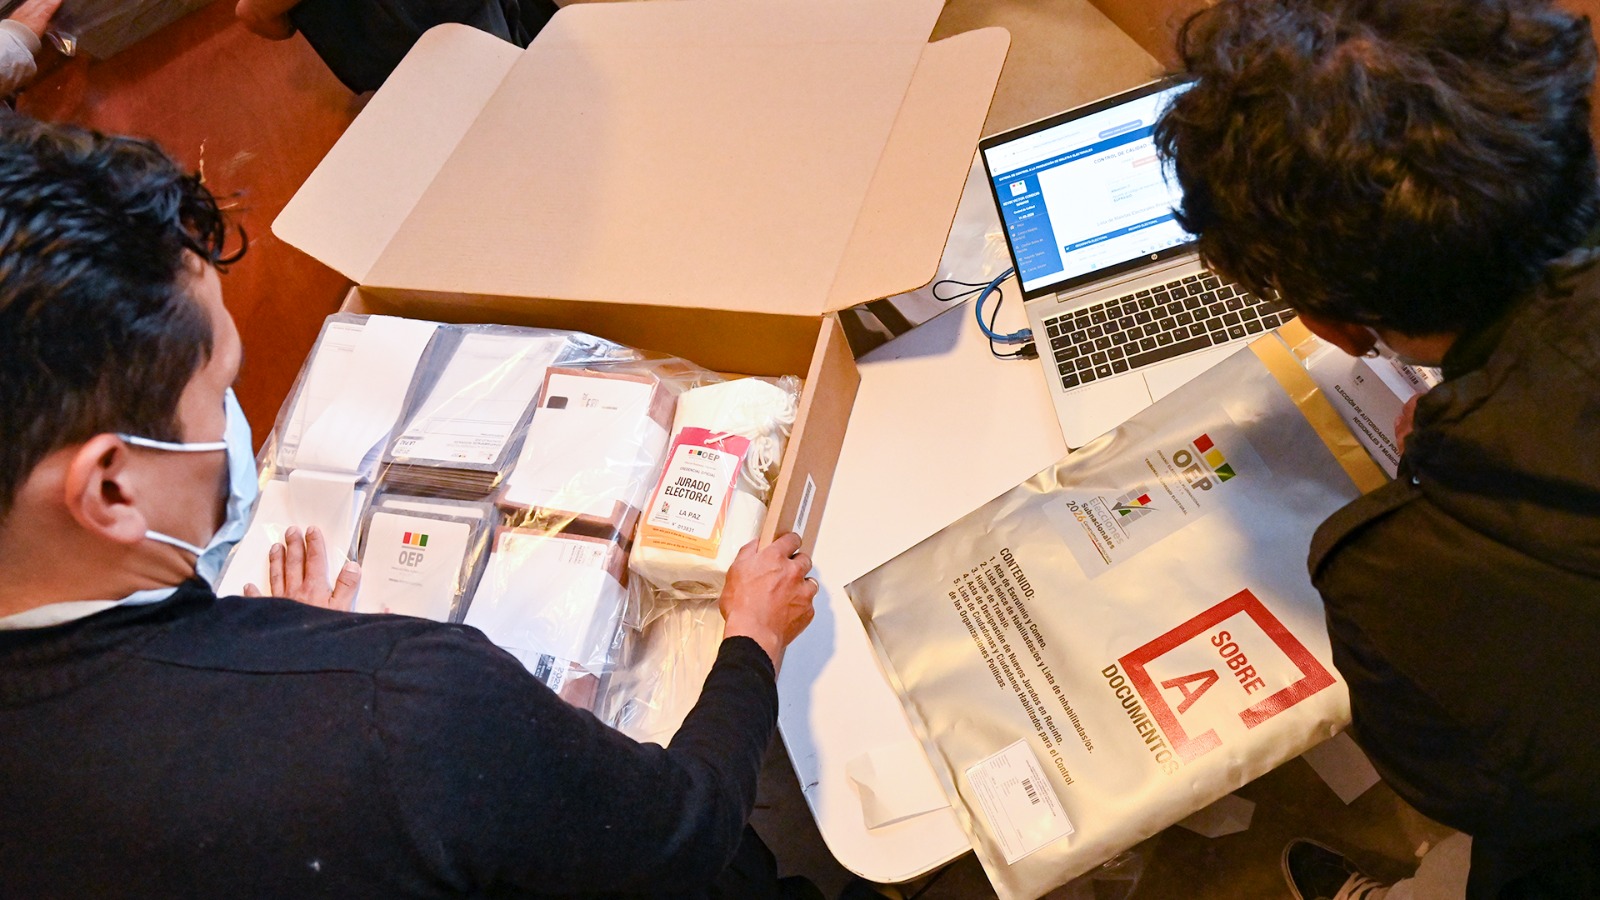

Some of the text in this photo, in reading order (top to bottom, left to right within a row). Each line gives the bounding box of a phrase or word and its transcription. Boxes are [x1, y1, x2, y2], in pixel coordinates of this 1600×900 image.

[1093, 153, 1117, 164] CONTROL
[1125, 143, 1147, 153] CALIDAD
[1334, 384, 1356, 408] ELECCIÓN
[1354, 405, 1363, 413] DE
[1360, 412, 1390, 444] AUTORIDADES
[1353, 417, 1379, 445] REGIONALES
[702, 451, 720, 461] OEP
[1173, 450, 1212, 491] OEP
[665, 486, 713, 505] ELECTORAL
[675, 477, 710, 492] JURADO
[688, 511, 701, 520] PAZ
[1066, 501, 1085, 522] 2026
[1081, 503, 1115, 550] Subnacionales
[1089, 497, 1123, 545] Elecciones
[399, 551, 424, 567] OEP
[999, 547, 1035, 600] CONTENIDO:
[975, 574, 989, 594] Hojas
[992, 602, 1009, 630] Trabajo.
[994, 564, 1004, 578] Acta
[1007, 586, 1029, 619] Escrutinio
[1030, 624, 1046, 650] Conteo.
[954, 599, 962, 610] las
[960, 610, 989, 659] Organizaciones
[986, 658, 1005, 690] Políticas.
[967, 581, 978, 596] Acta
[980, 604, 1006, 644] Designación
[1008, 652, 1025, 678] Nuevos
[1022, 679, 1041, 706] Jurados
[1044, 715, 1062, 745] Recinto.
[985, 569, 996, 586] Lista
[994, 584, 1008, 606] Índice
[1011, 614, 1041, 662] Habilitadas/os
[1042, 666, 1054, 685] Lista
[1058, 694, 1093, 754] Inhabilitadas/os.
[1211, 630, 1266, 695] SOBRE
[958, 586, 970, 602] Lista
[972, 611, 996, 649] Ciudadanas
[996, 654, 1021, 692] Ciudadanos
[1018, 692, 1043, 731] Habilitados
[1038, 732, 1052, 748] para
[1054, 753, 1074, 786] Control
[1160, 669, 1220, 715] A
[1101, 664, 1179, 775] DOCUMENTOS
